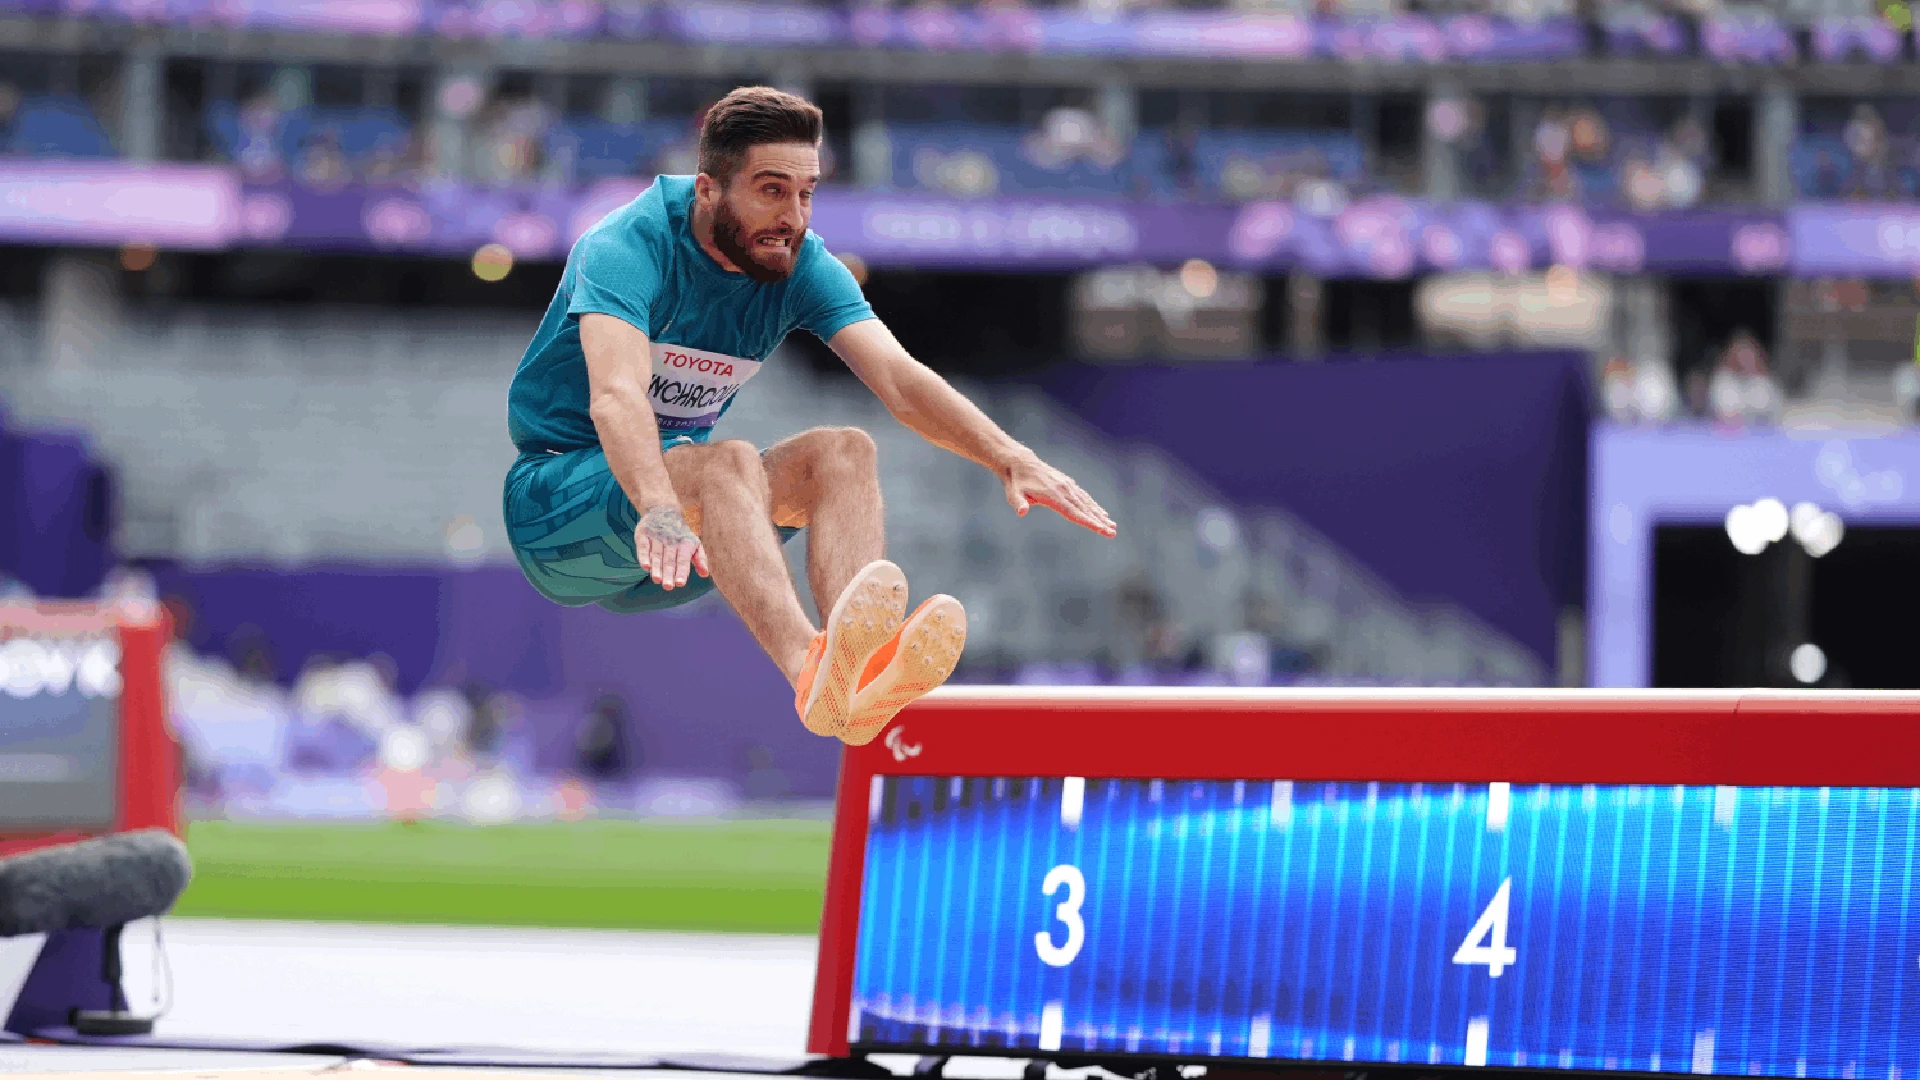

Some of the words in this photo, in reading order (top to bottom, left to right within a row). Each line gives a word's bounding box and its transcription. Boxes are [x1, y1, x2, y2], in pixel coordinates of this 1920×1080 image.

[663, 352, 734, 376] TOYOTA
[1034, 864, 1086, 967] 3
[1451, 876, 1517, 978] 4
